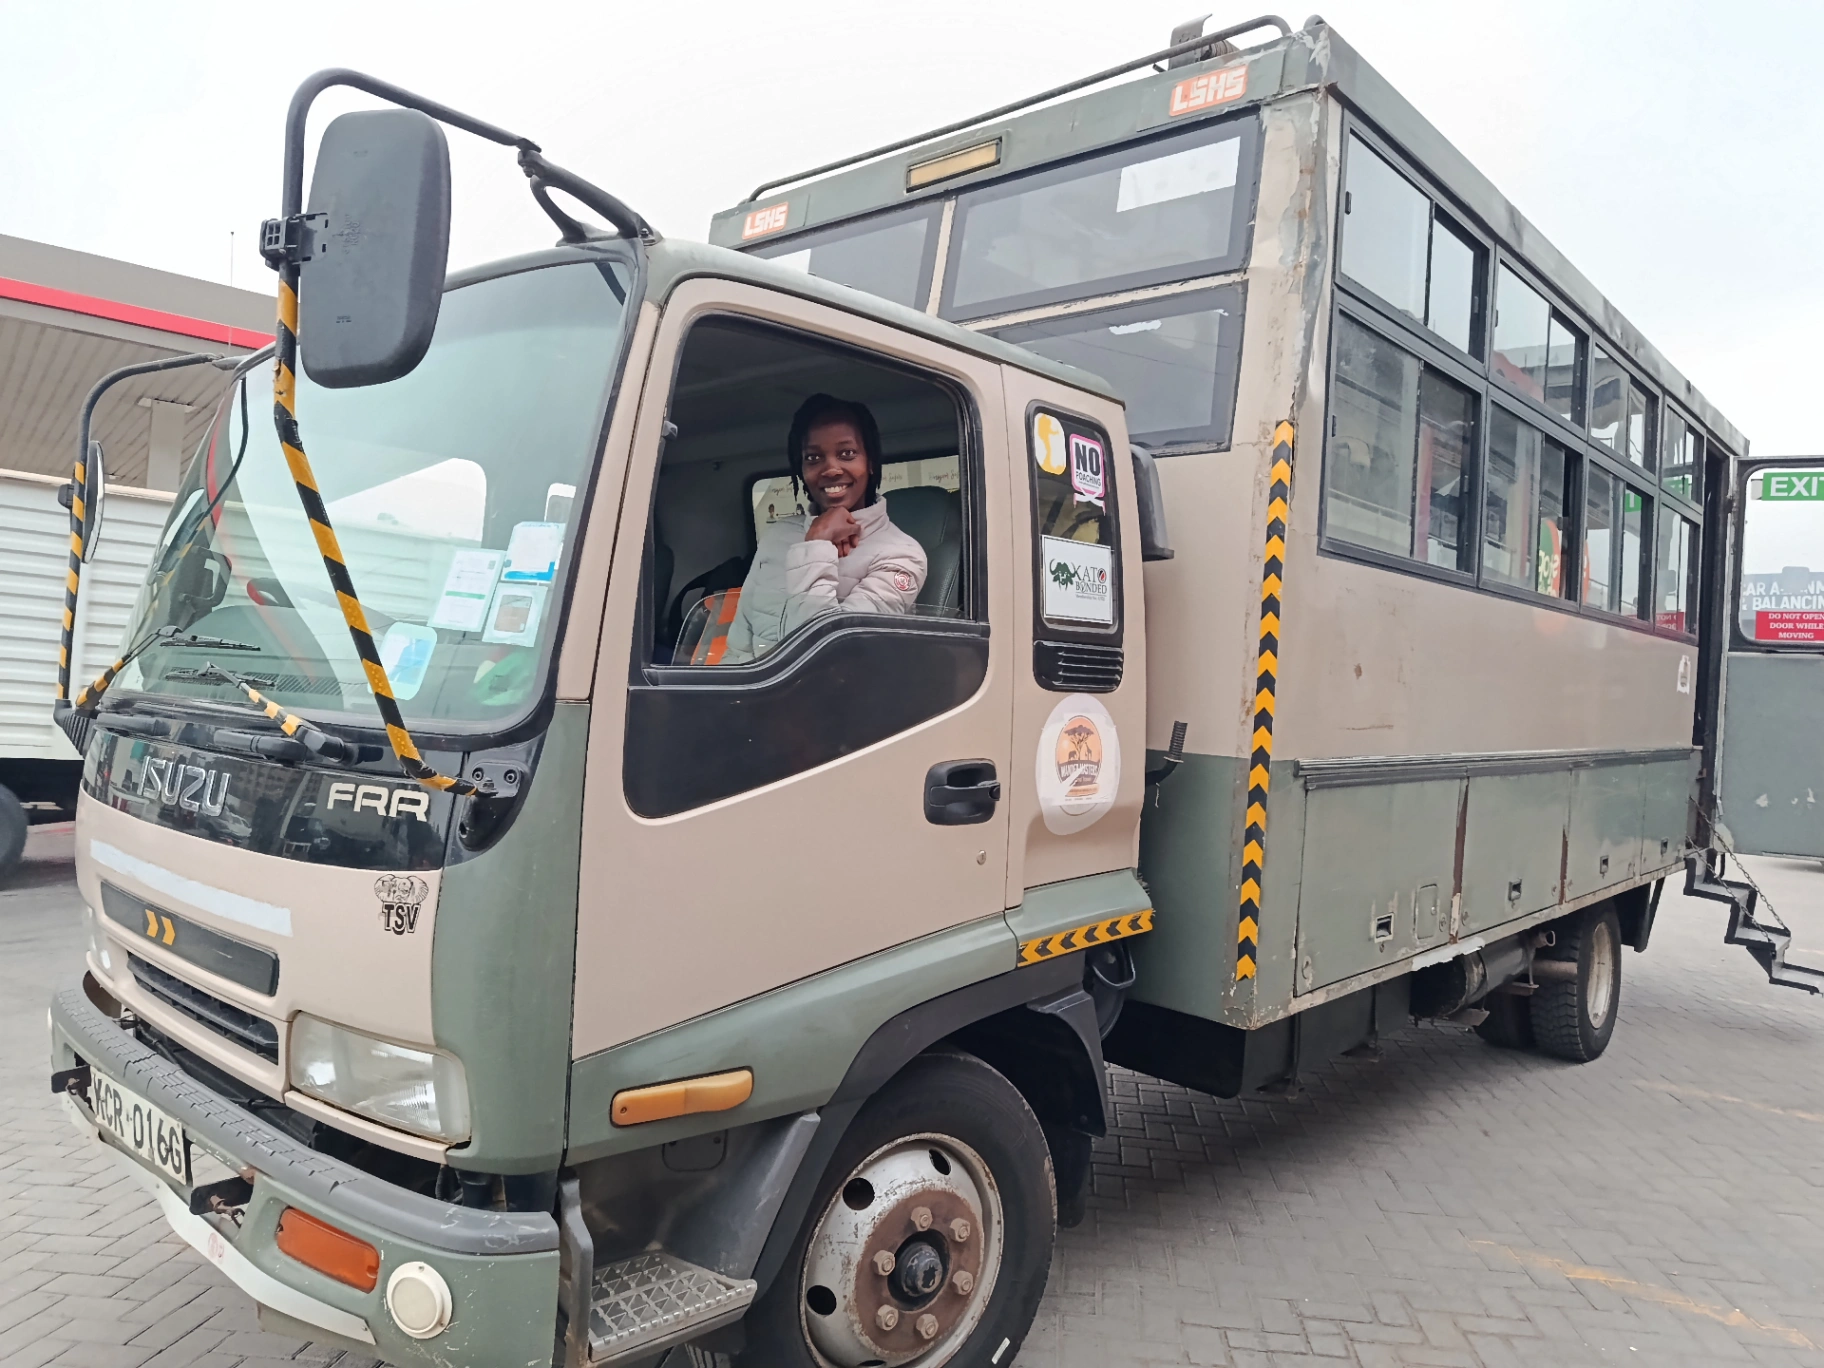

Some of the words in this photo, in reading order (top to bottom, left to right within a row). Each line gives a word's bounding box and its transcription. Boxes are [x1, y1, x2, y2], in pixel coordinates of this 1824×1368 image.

[1172, 67, 1247, 112] LSHS
[744, 205, 788, 237] LSHS
[1074, 441, 1101, 477] NO
[1075, 581, 1108, 595] BONDED
[1778, 631, 1815, 639] MOVING
[1796, 622, 1824, 630] WHILE
[136, 755, 232, 818] ISUZU
[326, 782, 430, 823] FRR
[381, 902, 421, 936] TSV
